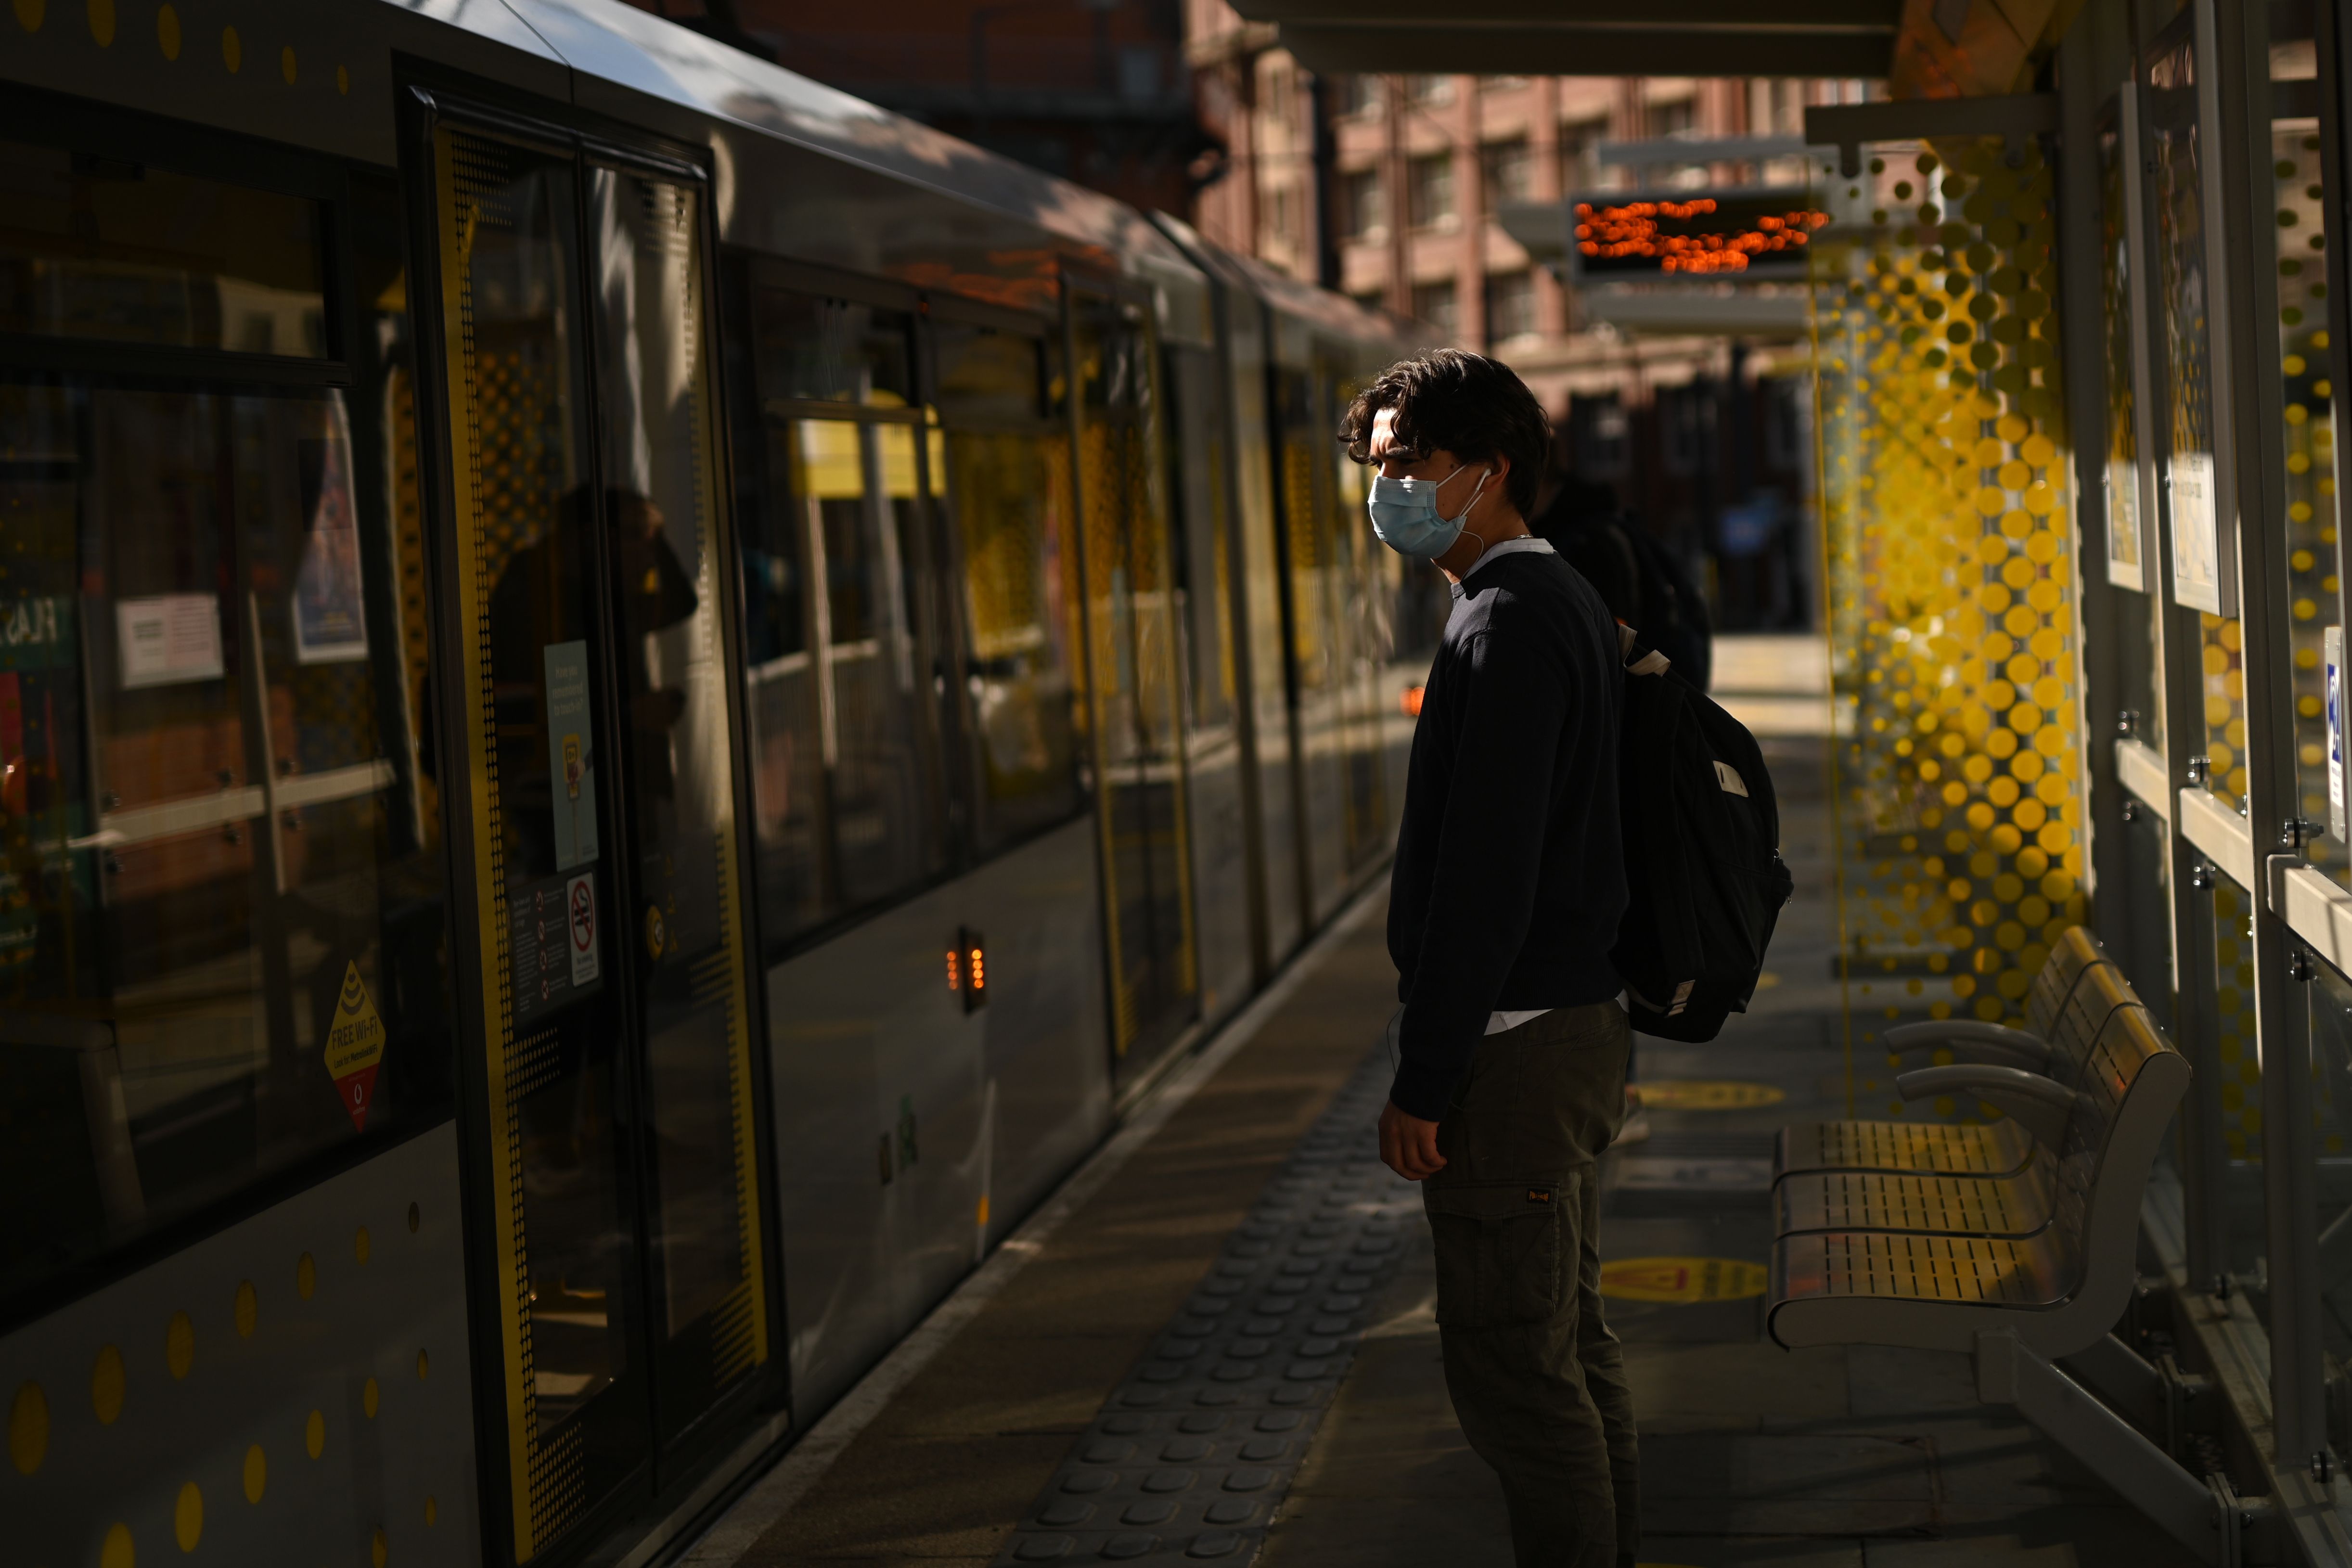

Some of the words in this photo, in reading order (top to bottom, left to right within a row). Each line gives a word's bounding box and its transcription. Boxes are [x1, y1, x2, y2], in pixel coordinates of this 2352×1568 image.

[555, 666, 568, 678] Have
[568, 665, 578, 681] you
[553, 681, 583, 699] remembered
[554, 704, 559, 716] to
[332, 1024, 354, 1050] FREE
[355, 1015, 378, 1041] Wi-Fi
[334, 1056, 344, 1069] Look
[353, 1106, 365, 1115] vodafone
